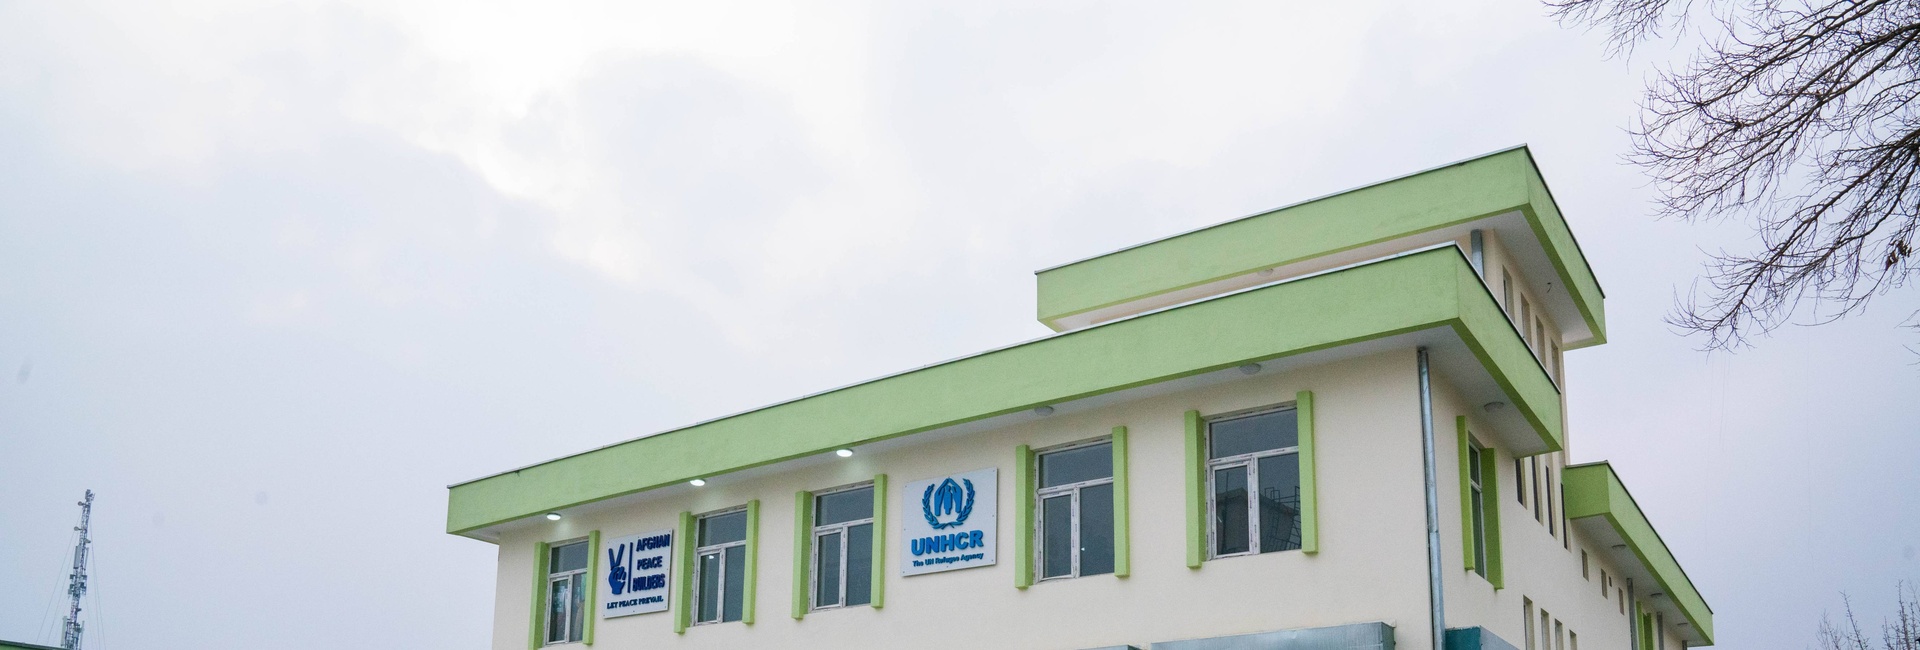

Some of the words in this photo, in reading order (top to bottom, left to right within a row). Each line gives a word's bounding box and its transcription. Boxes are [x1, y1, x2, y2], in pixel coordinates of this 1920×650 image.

[636, 534, 671, 552] AFGHAN
[911, 530, 984, 556] UNHCR
[637, 556, 663, 570] PEACE
[925, 558, 934, 566] UN
[935, 556, 960, 564] Refugee
[961, 553, 984, 561] Agency
[632, 573, 666, 592] BUILDERS
[619, 599, 638, 608] PEACE
